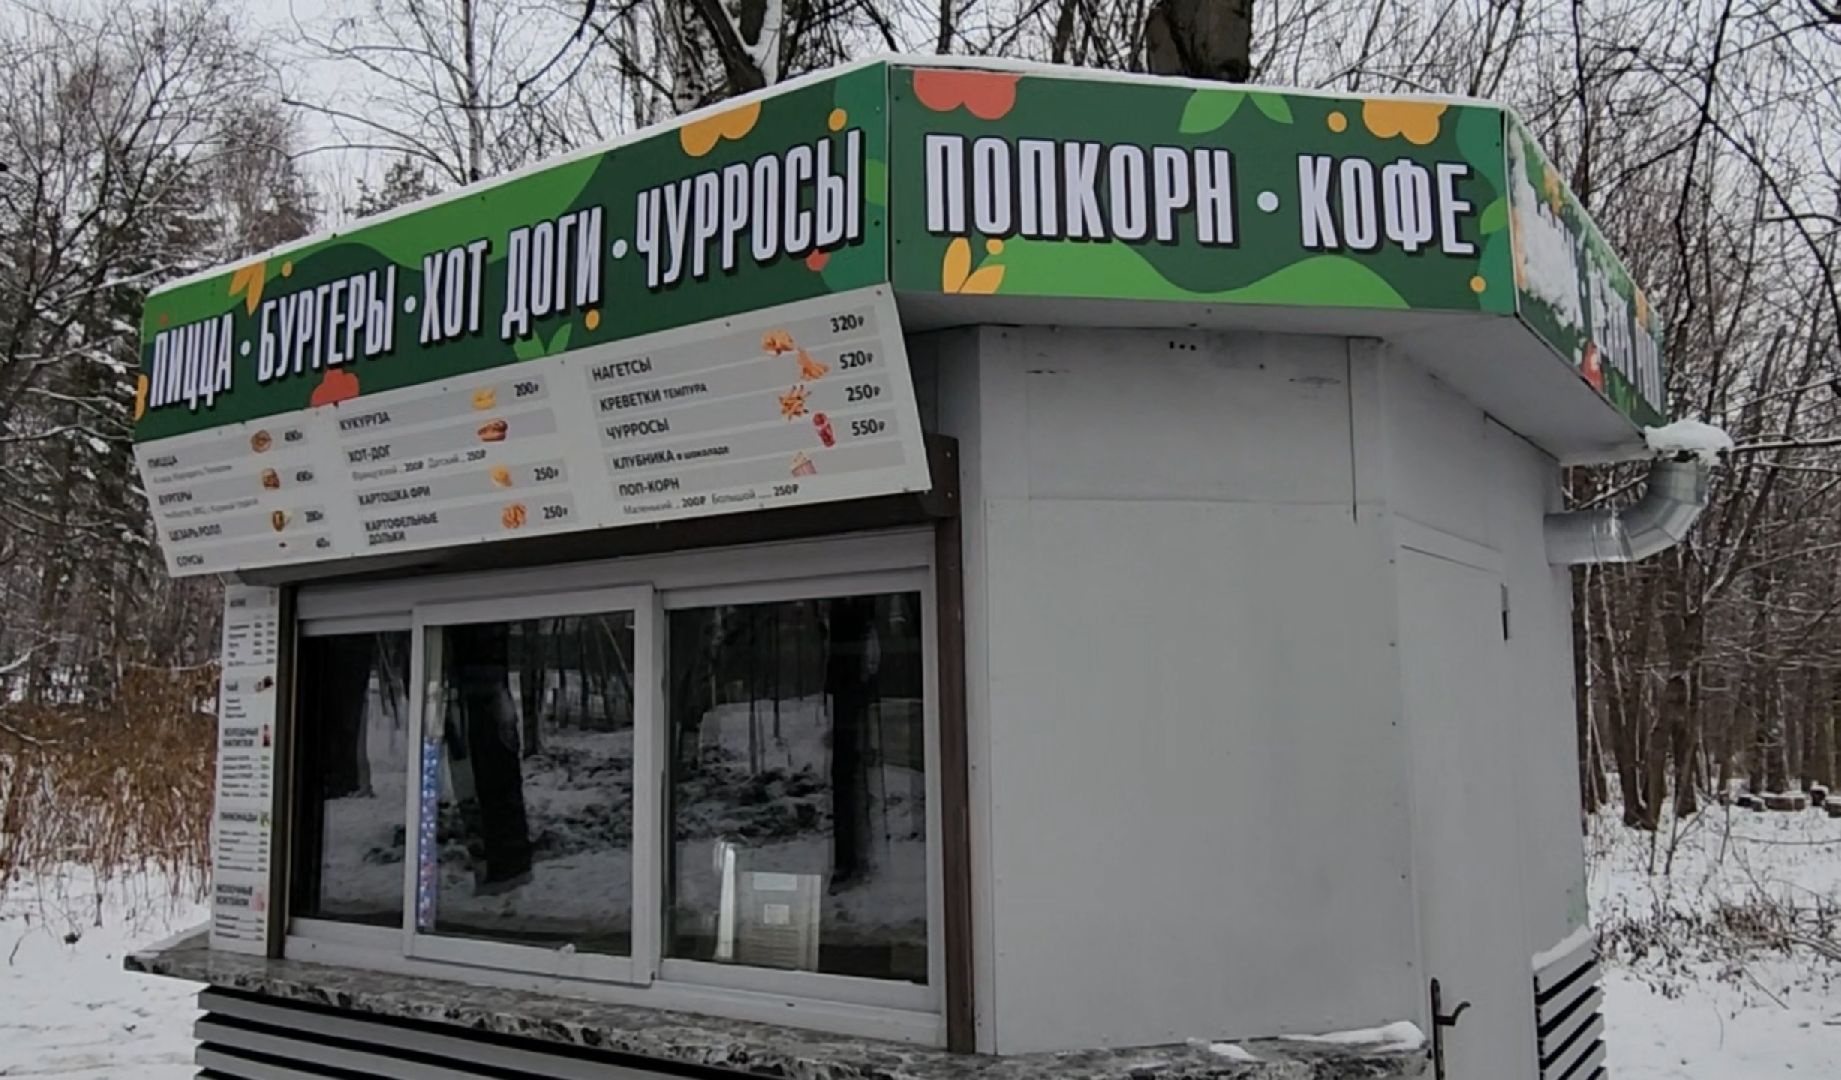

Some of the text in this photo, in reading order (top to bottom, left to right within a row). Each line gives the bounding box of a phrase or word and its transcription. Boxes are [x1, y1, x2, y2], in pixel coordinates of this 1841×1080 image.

[925, 133, 1236, 246] ПОПКОРН
[1298, 154, 1477, 255] КОФЕ
[150, 128, 862, 412] ПИЦЦА БУРГЕРЫ ХОТ ДОГИ ЧУРРОСЫ
[591, 356, 652, 381] НАГЕТСЫ
[600, 388, 662, 412] КРЕВЕТКИ
[339, 411, 391, 431] КУКУРУЗА
[605, 417, 671, 440] ЧУРРОСЫ
[347, 444, 391, 463] ХОТ-ДОГ
[612, 448, 675, 470] КЛУБНИКА
[357, 488, 409, 506] КАРТОШКА
[410, 485, 431, 498] ФРИ
[619, 477, 680, 497] ПОП-КОРН
